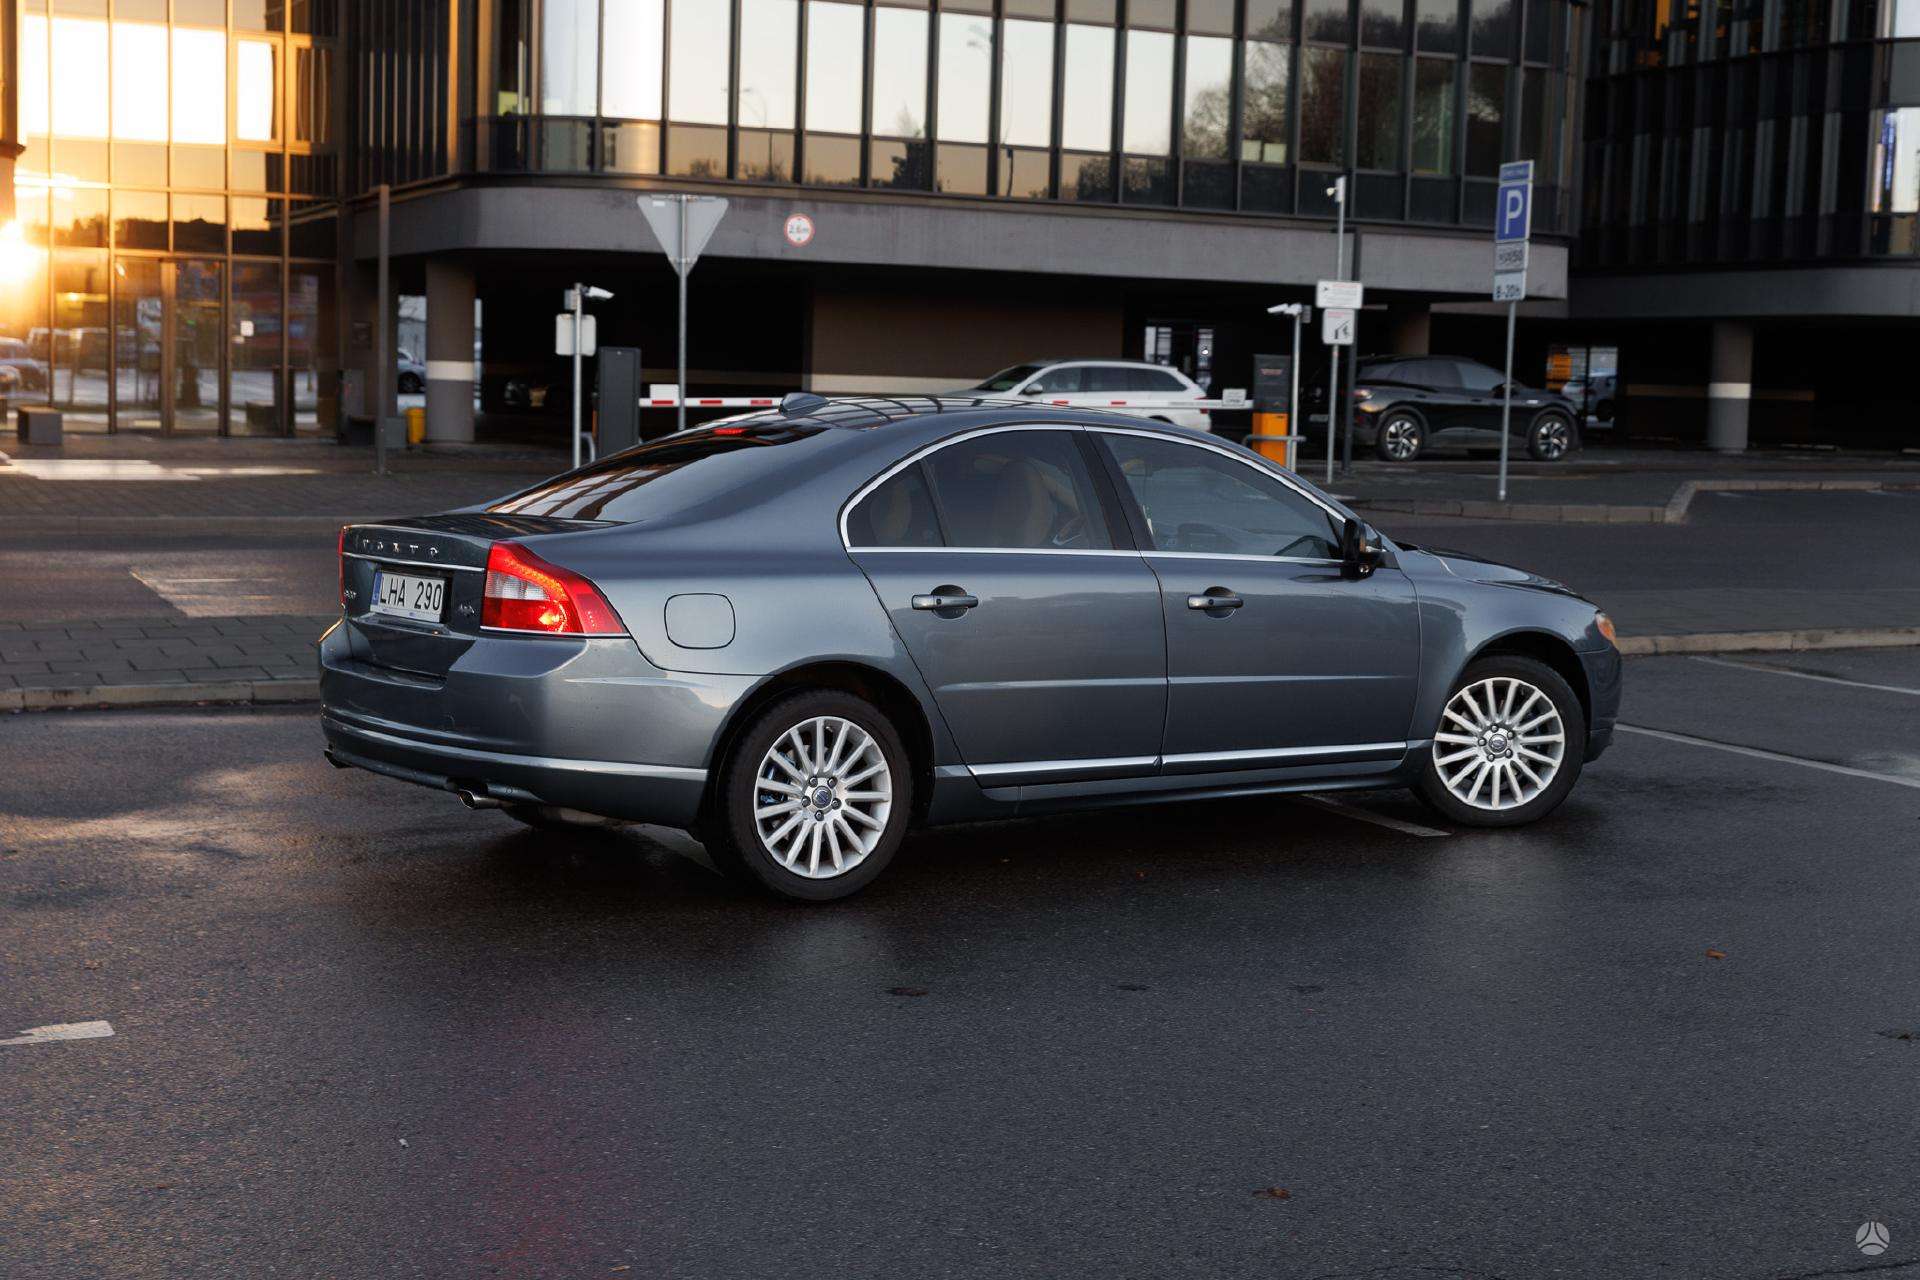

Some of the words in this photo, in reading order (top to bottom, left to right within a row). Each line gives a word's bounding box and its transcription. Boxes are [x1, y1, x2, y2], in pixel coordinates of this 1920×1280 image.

[1505, 190, 1523, 235] P
[380, 577, 405, 607] LHA
[414, 580, 442, 611] 290
